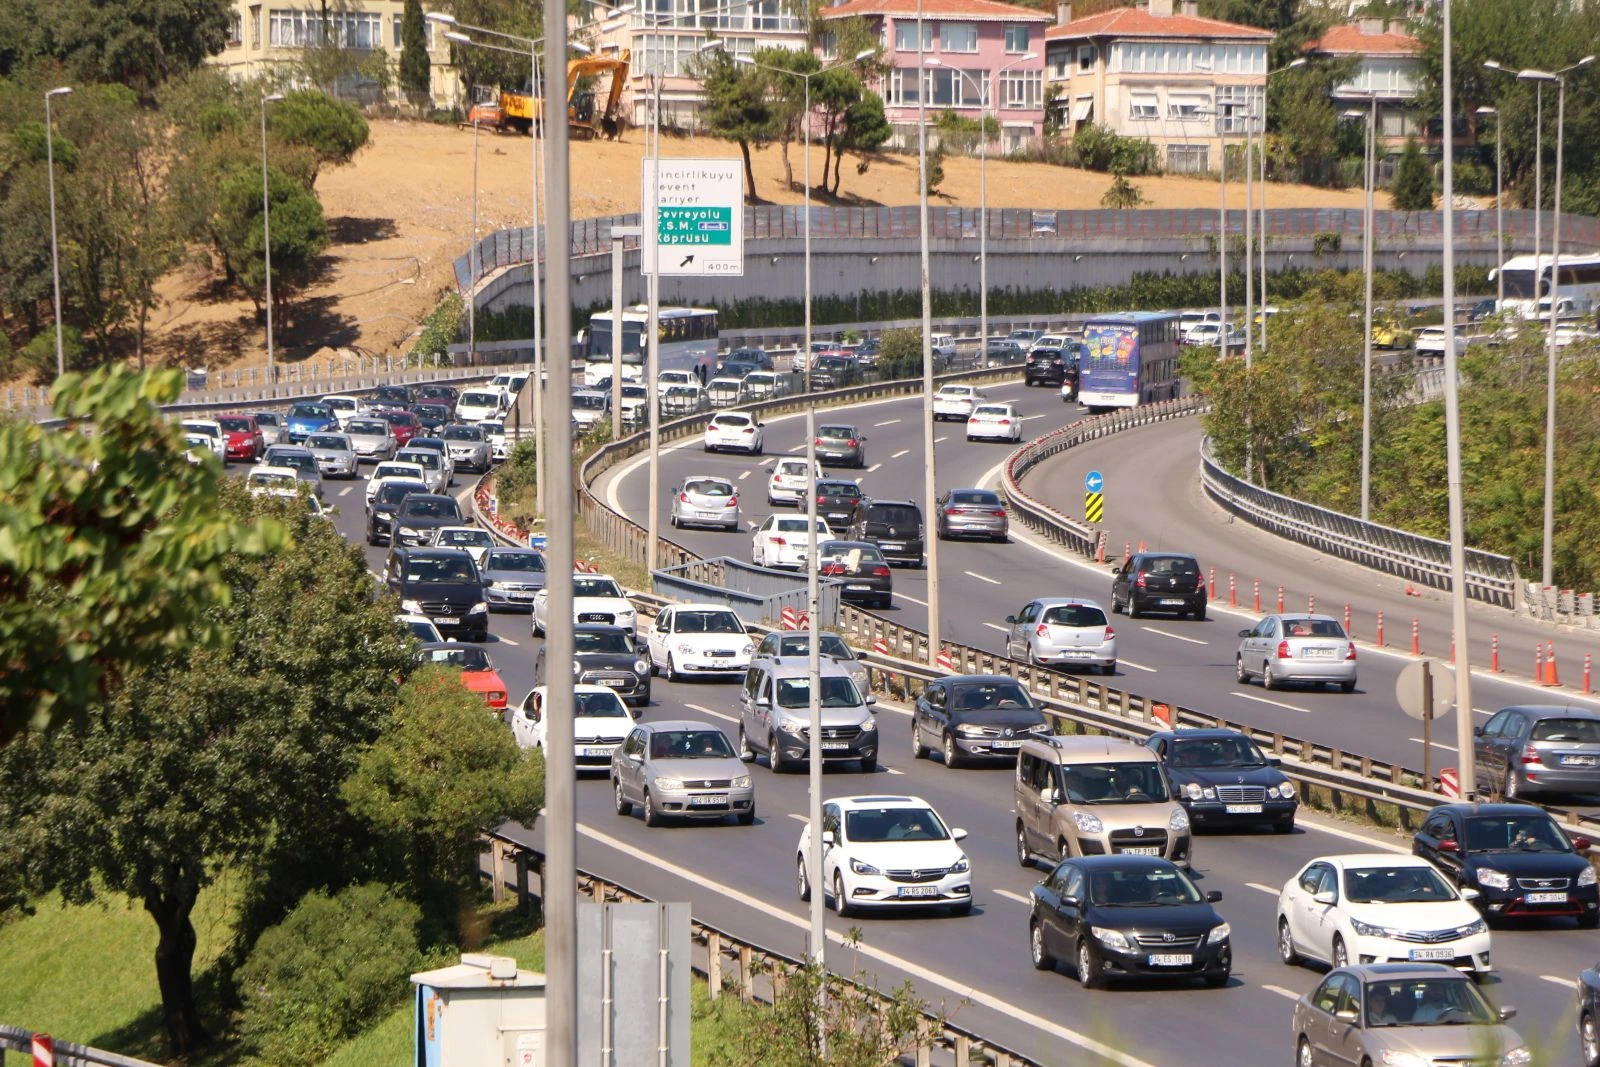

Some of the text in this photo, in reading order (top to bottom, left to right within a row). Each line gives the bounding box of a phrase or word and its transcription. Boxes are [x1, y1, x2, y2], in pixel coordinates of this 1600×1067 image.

[657, 170, 733, 182] incirlikuyu
[658, 196, 700, 205] arıyer
[707, 263, 739, 271] 400m
[1414, 950, 1421, 958] 34
[1424, 950, 1432, 958] RA
